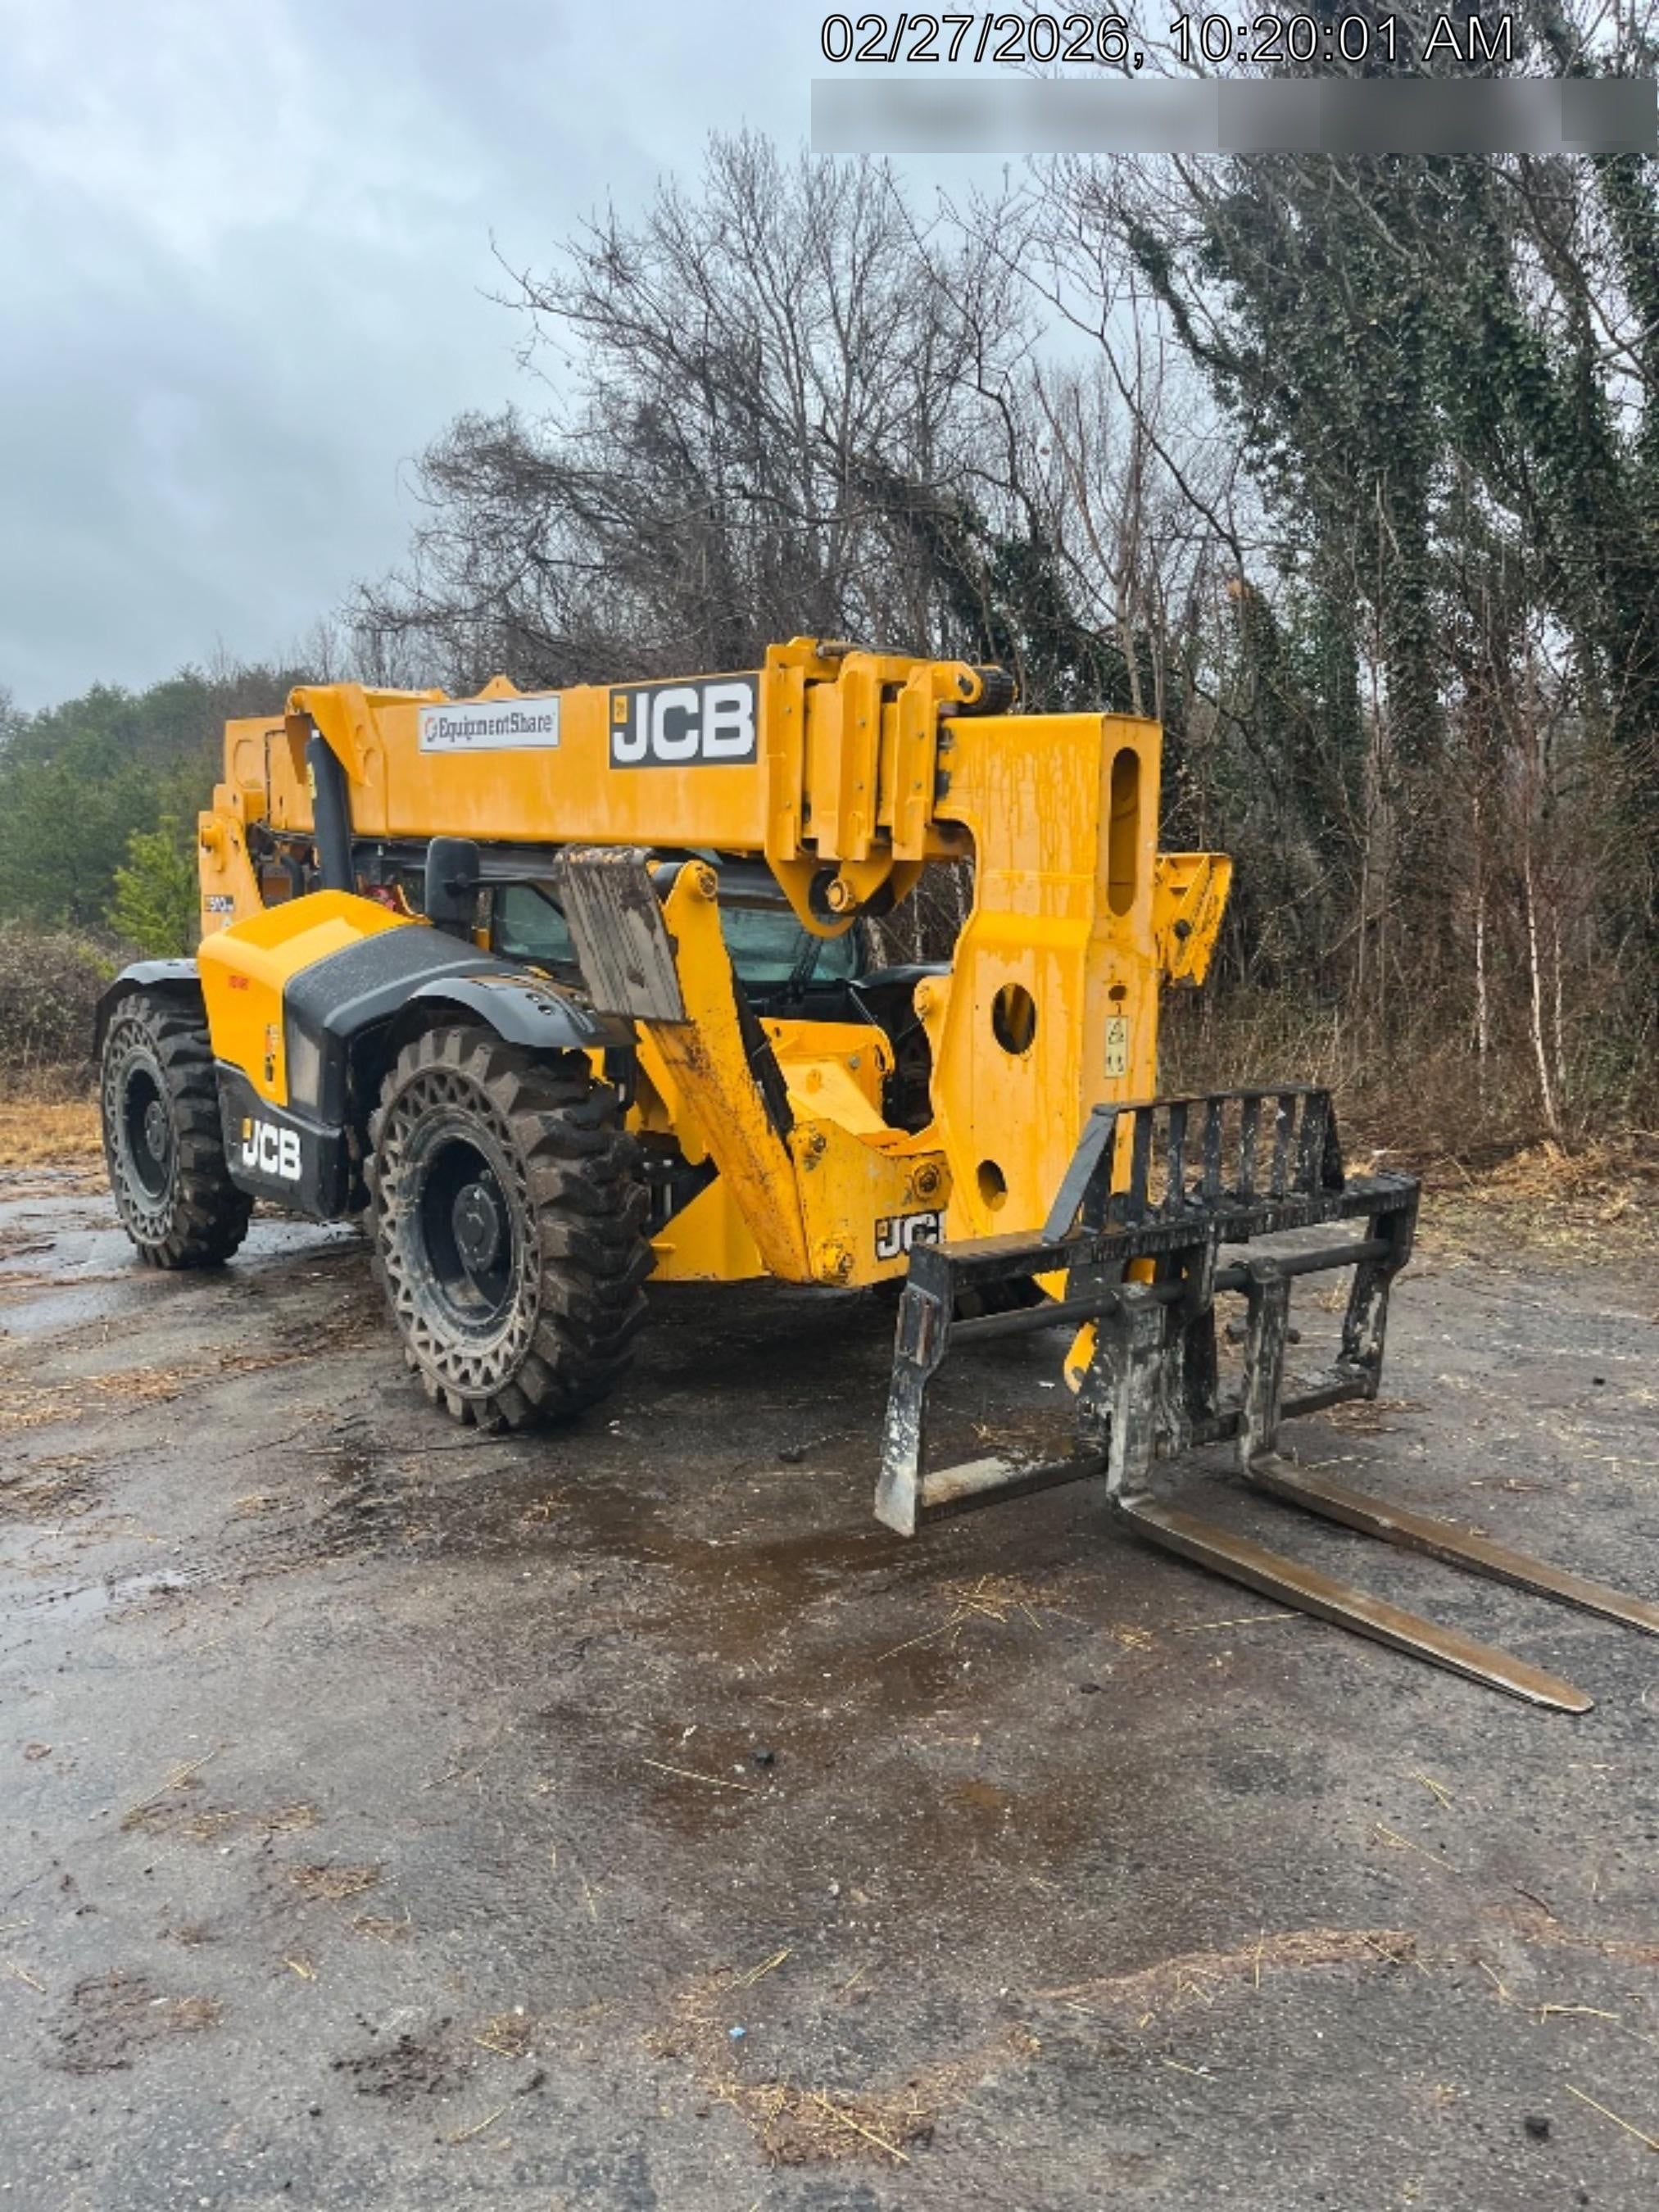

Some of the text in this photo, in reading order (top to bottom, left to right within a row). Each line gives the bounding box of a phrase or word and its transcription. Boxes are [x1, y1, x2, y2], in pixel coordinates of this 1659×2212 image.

[439, 712, 553, 743] EquipmentShare
[613, 682, 755, 762] JCB
[243, 1120, 302, 1181] JCB
[877, 1213, 945, 1258] JC
